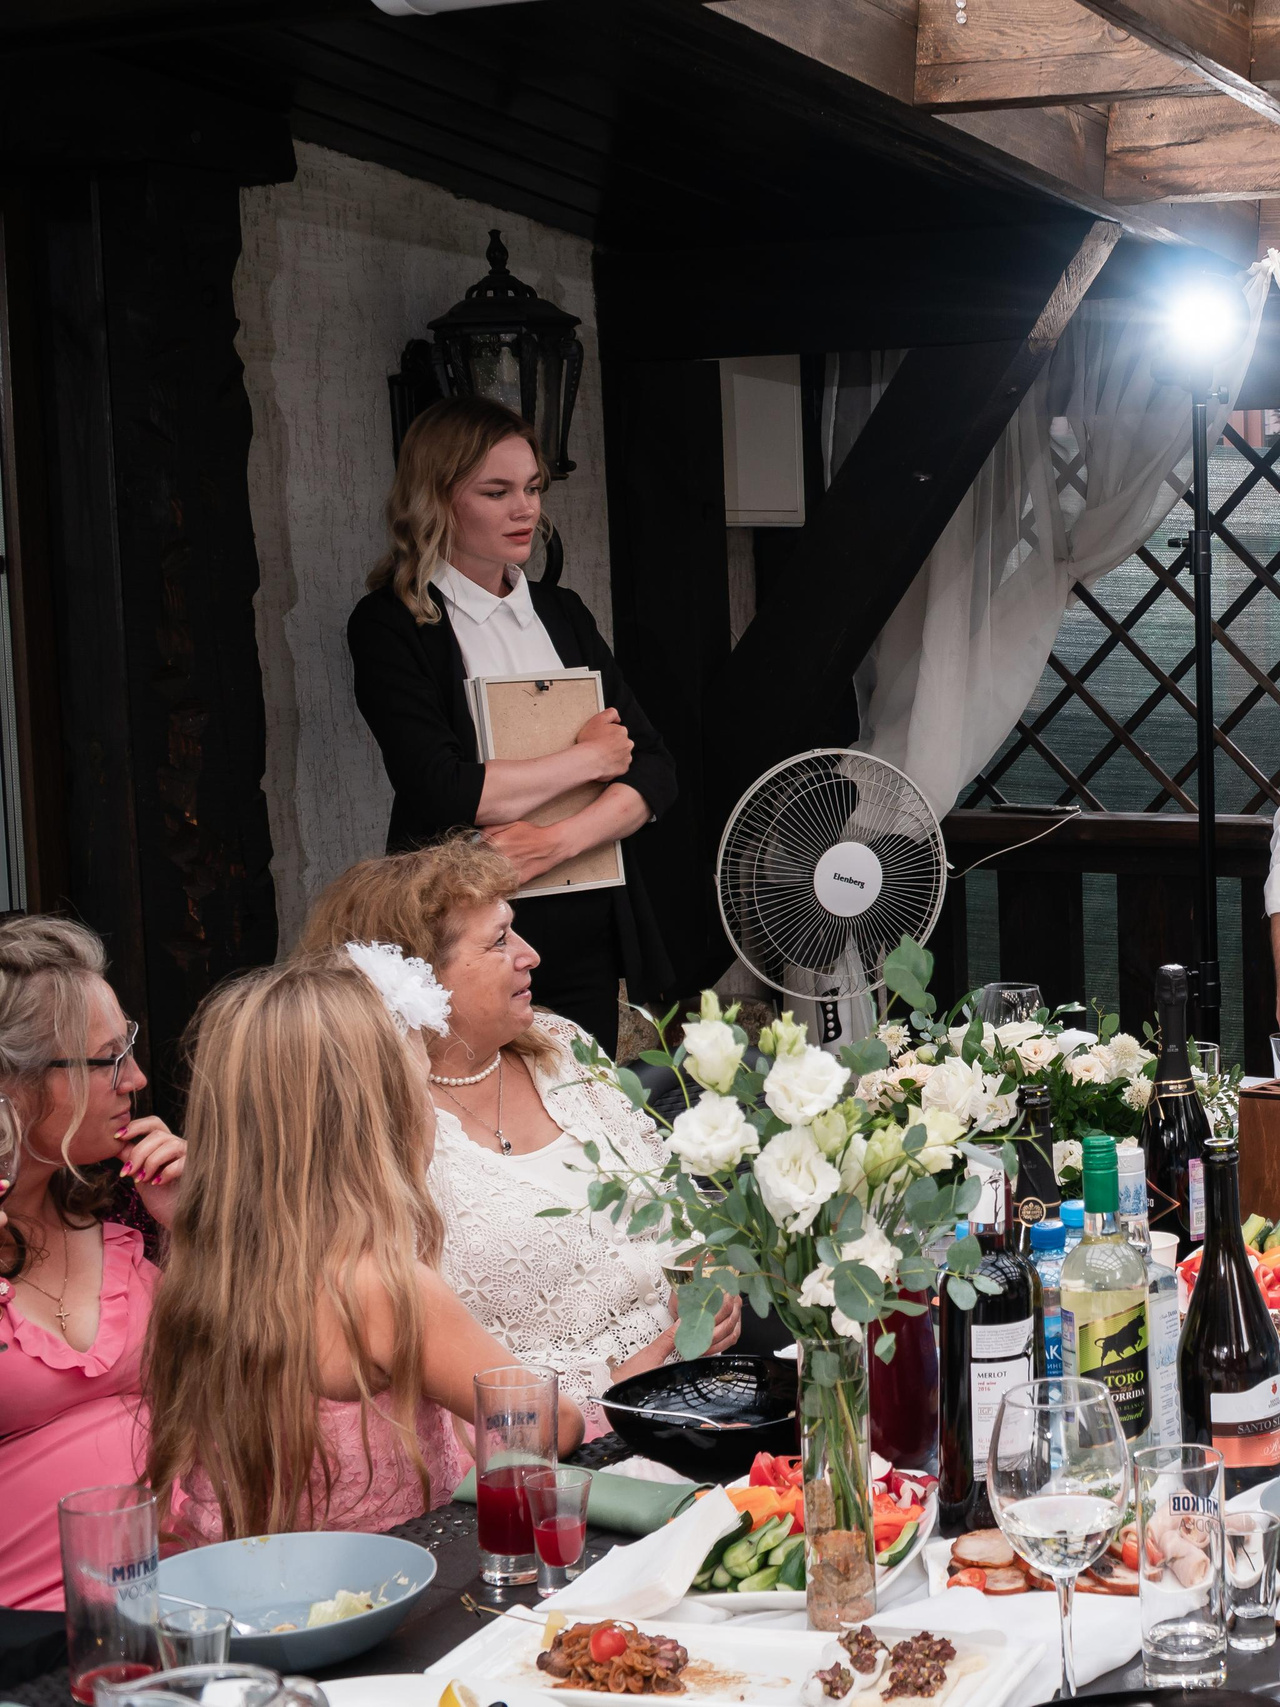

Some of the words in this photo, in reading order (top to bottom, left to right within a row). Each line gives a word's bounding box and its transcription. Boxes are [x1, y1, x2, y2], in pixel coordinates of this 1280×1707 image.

[833, 872, 865, 889] Elenberg
[977, 1371, 1008, 1379] MERLOT
[1103, 1370, 1144, 1387] TORO
[1110, 1388, 1145, 1402] ORRIDA
[1237, 1420, 1272, 1434] SANTO
